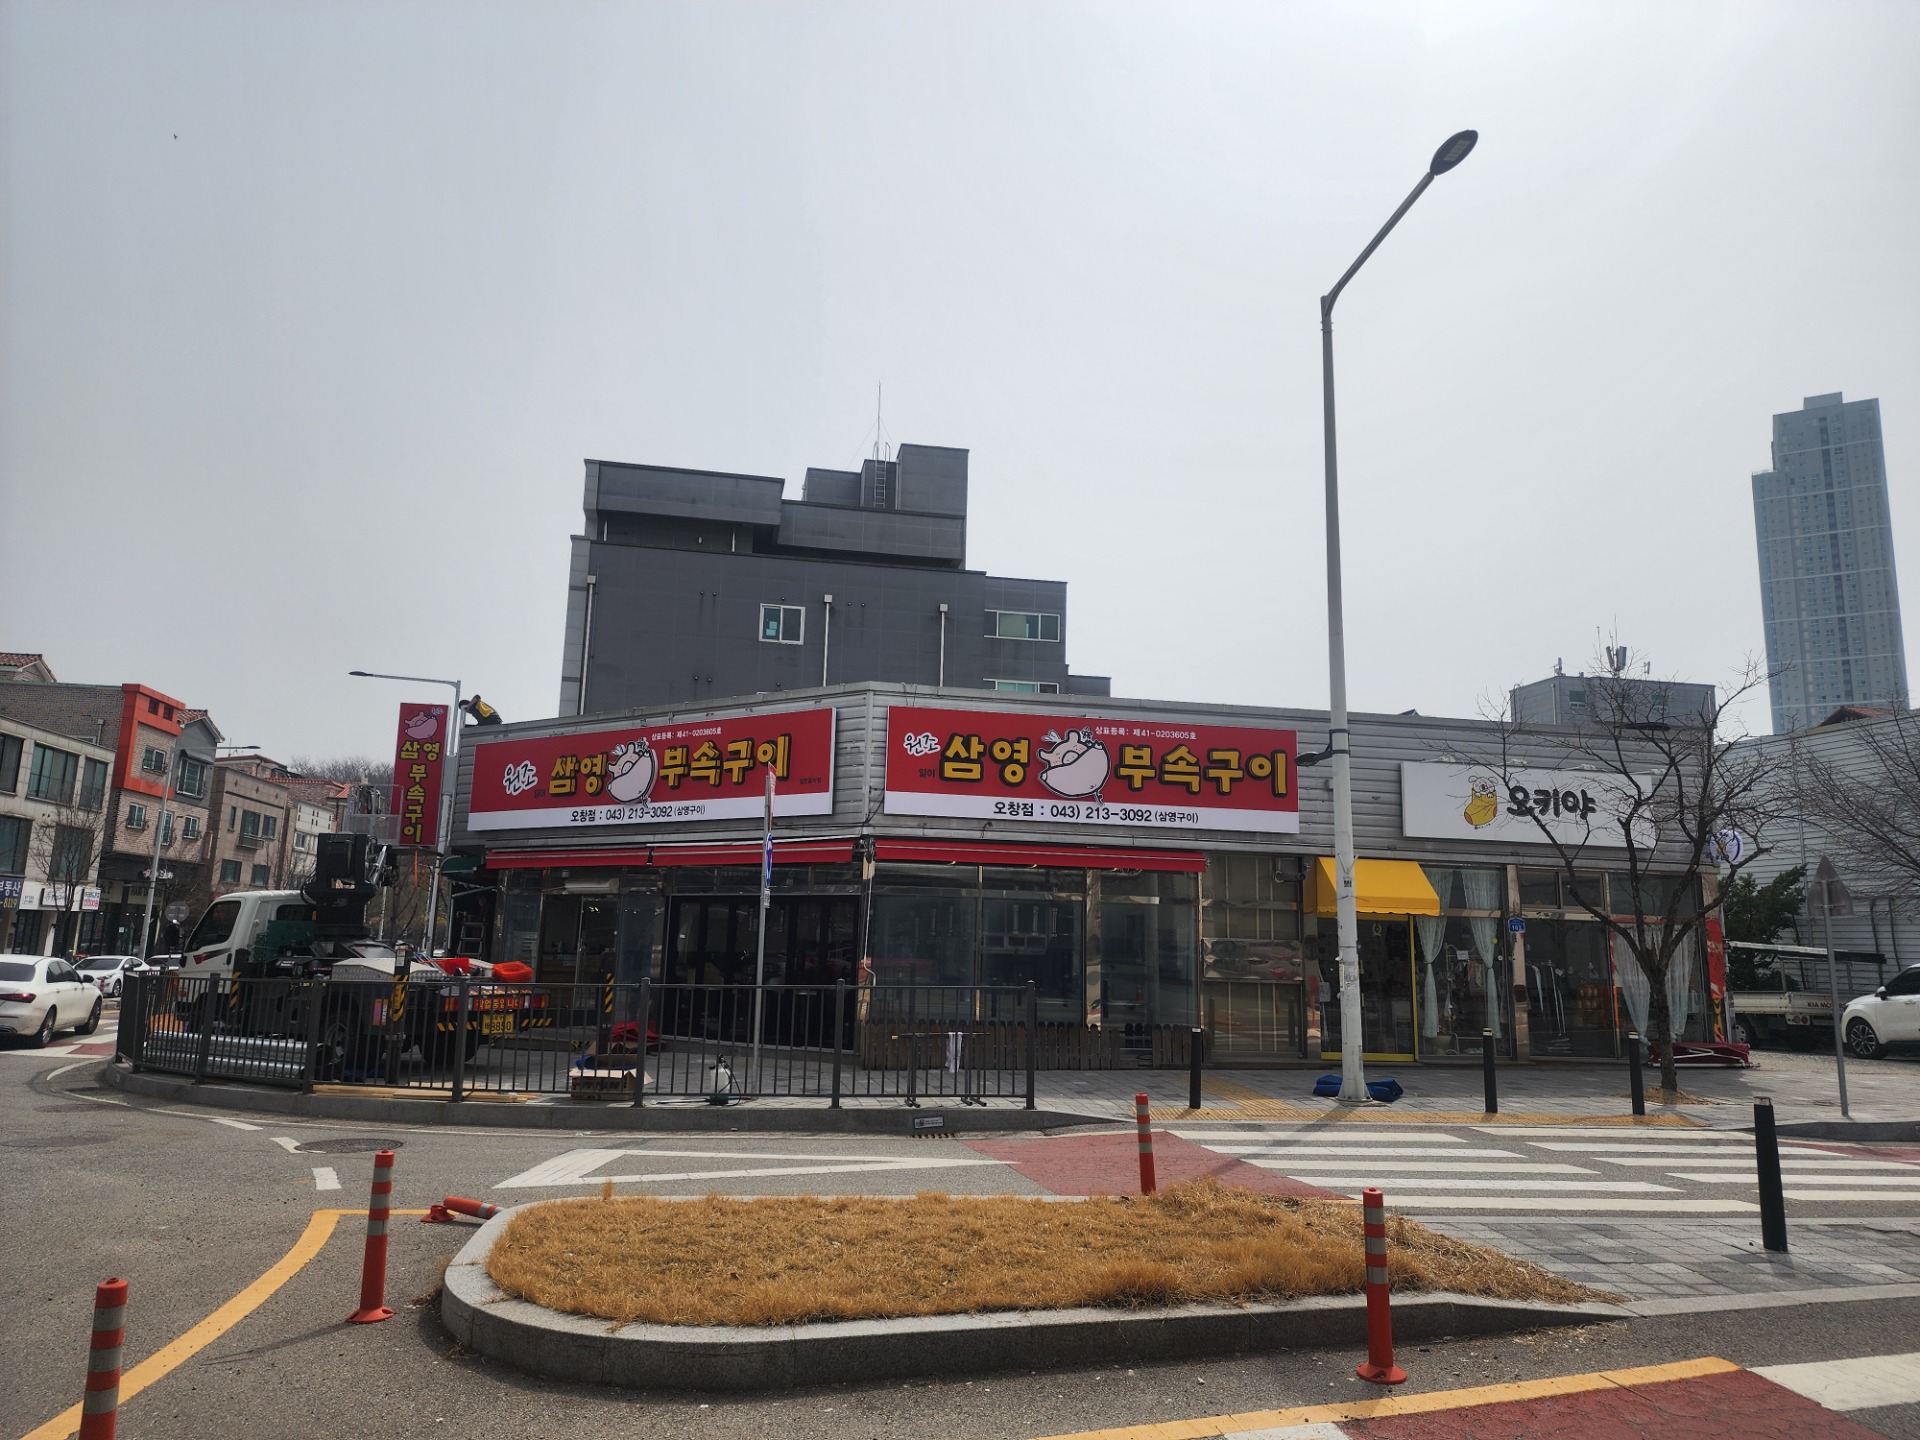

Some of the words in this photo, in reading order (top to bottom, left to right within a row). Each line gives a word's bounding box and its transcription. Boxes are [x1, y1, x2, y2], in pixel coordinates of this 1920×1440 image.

[399, 740, 441, 763] 삼영
[903, 732, 940, 757] 원조
[503, 760, 538, 796] 원조
[548, 753, 608, 797] 삼영
[658, 734, 790, 789] 부속구이
[942, 734, 1029, 785] 삼영
[1116, 744, 1287, 795] 부속구이
[403, 764, 428, 843] 부속구이
[571, 809, 596, 822] 오창점
[605, 807, 625, 821] 043)
[628, 805, 672, 820] 213-3092
[674, 804, 706, 817] (삼영구이)
[993, 802, 1034, 817] 오창점
[1050, 804, 1081, 820] 043)
[1085, 806, 1152, 822] 213-3092
[1154, 810, 1199, 824] (삼영구이)
[1506, 786, 1597, 820] 오키야
